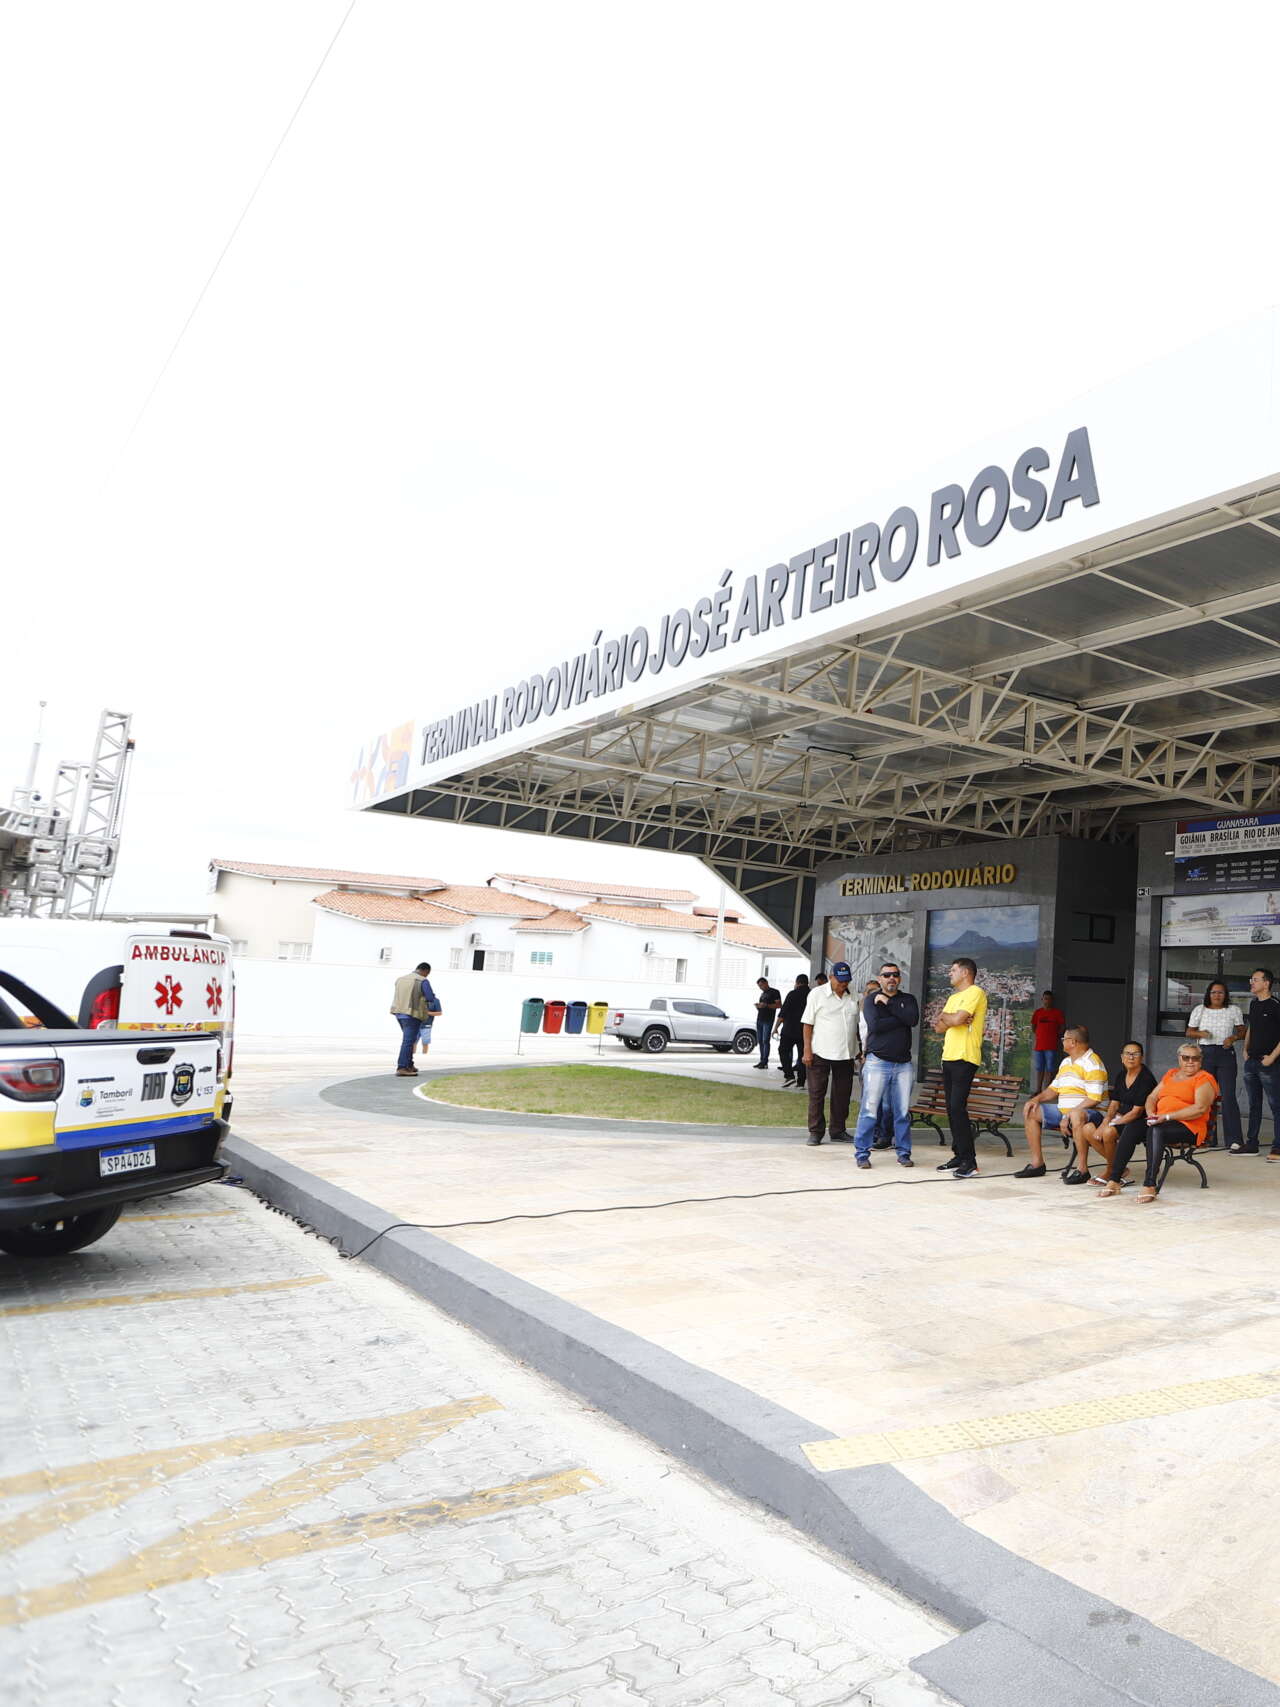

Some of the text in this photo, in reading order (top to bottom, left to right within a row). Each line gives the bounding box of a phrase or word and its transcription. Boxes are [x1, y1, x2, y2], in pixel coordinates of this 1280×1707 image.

[421, 426, 1100, 766] TERMINAL RODOVIÁRIO JOSÉ ARTEIRO ROSA
[1210, 829, 1240, 842] BRASÍLIA
[1244, 828, 1256, 839] RIO
[1257, 827, 1266, 837] DE
[838, 862, 1018, 897] TERMINAL RODOVIÁRIO
[131, 944, 226, 966] AMBULÂNCIA
[100, 1088, 133, 1100] Tamboril
